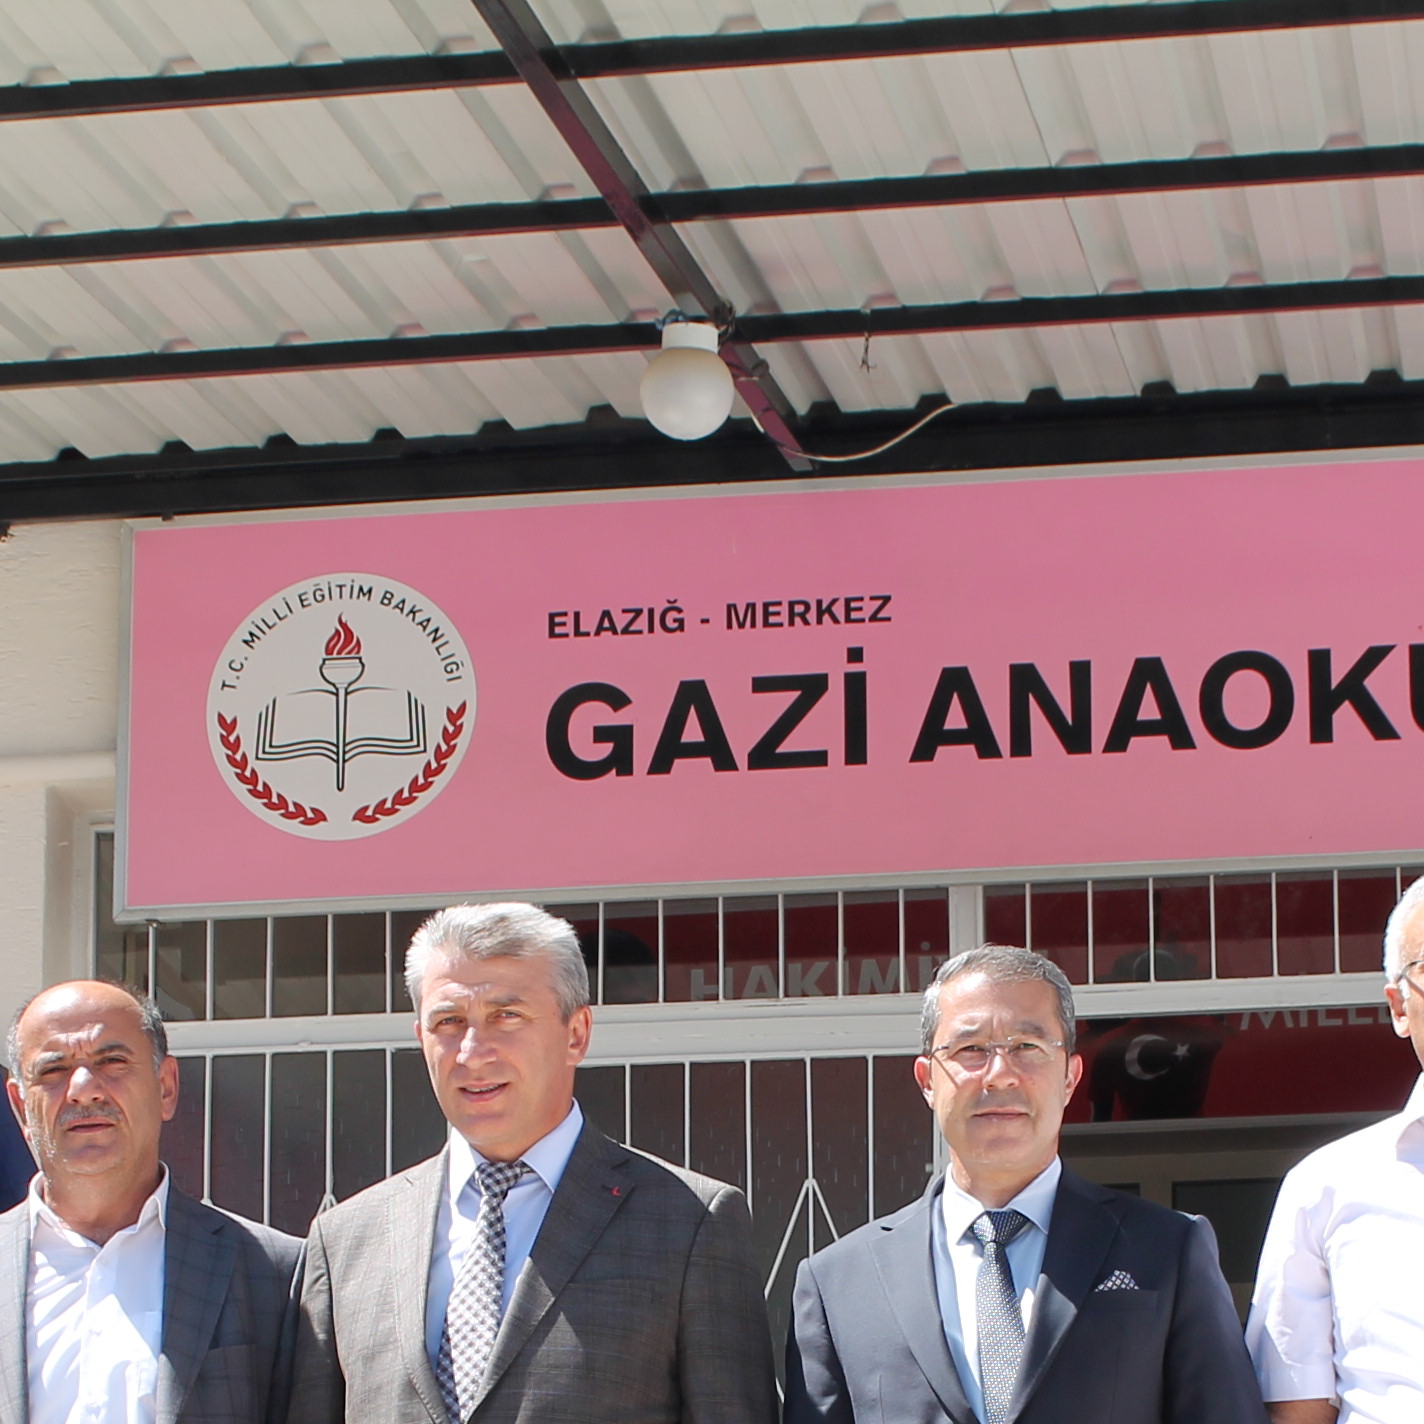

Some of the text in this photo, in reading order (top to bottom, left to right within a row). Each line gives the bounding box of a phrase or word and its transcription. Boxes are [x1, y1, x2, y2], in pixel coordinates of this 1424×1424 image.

[221, 579, 465, 692] T.C. MİLLİ EĞİTİM BAKANLIĞI
[548, 598, 686, 639] ELAZIĞ
[726, 595, 892, 630] MERKEZ
[546, 646, 868, 781] GAZİ
[690, 941, 950, 1001] HAKİMİ
